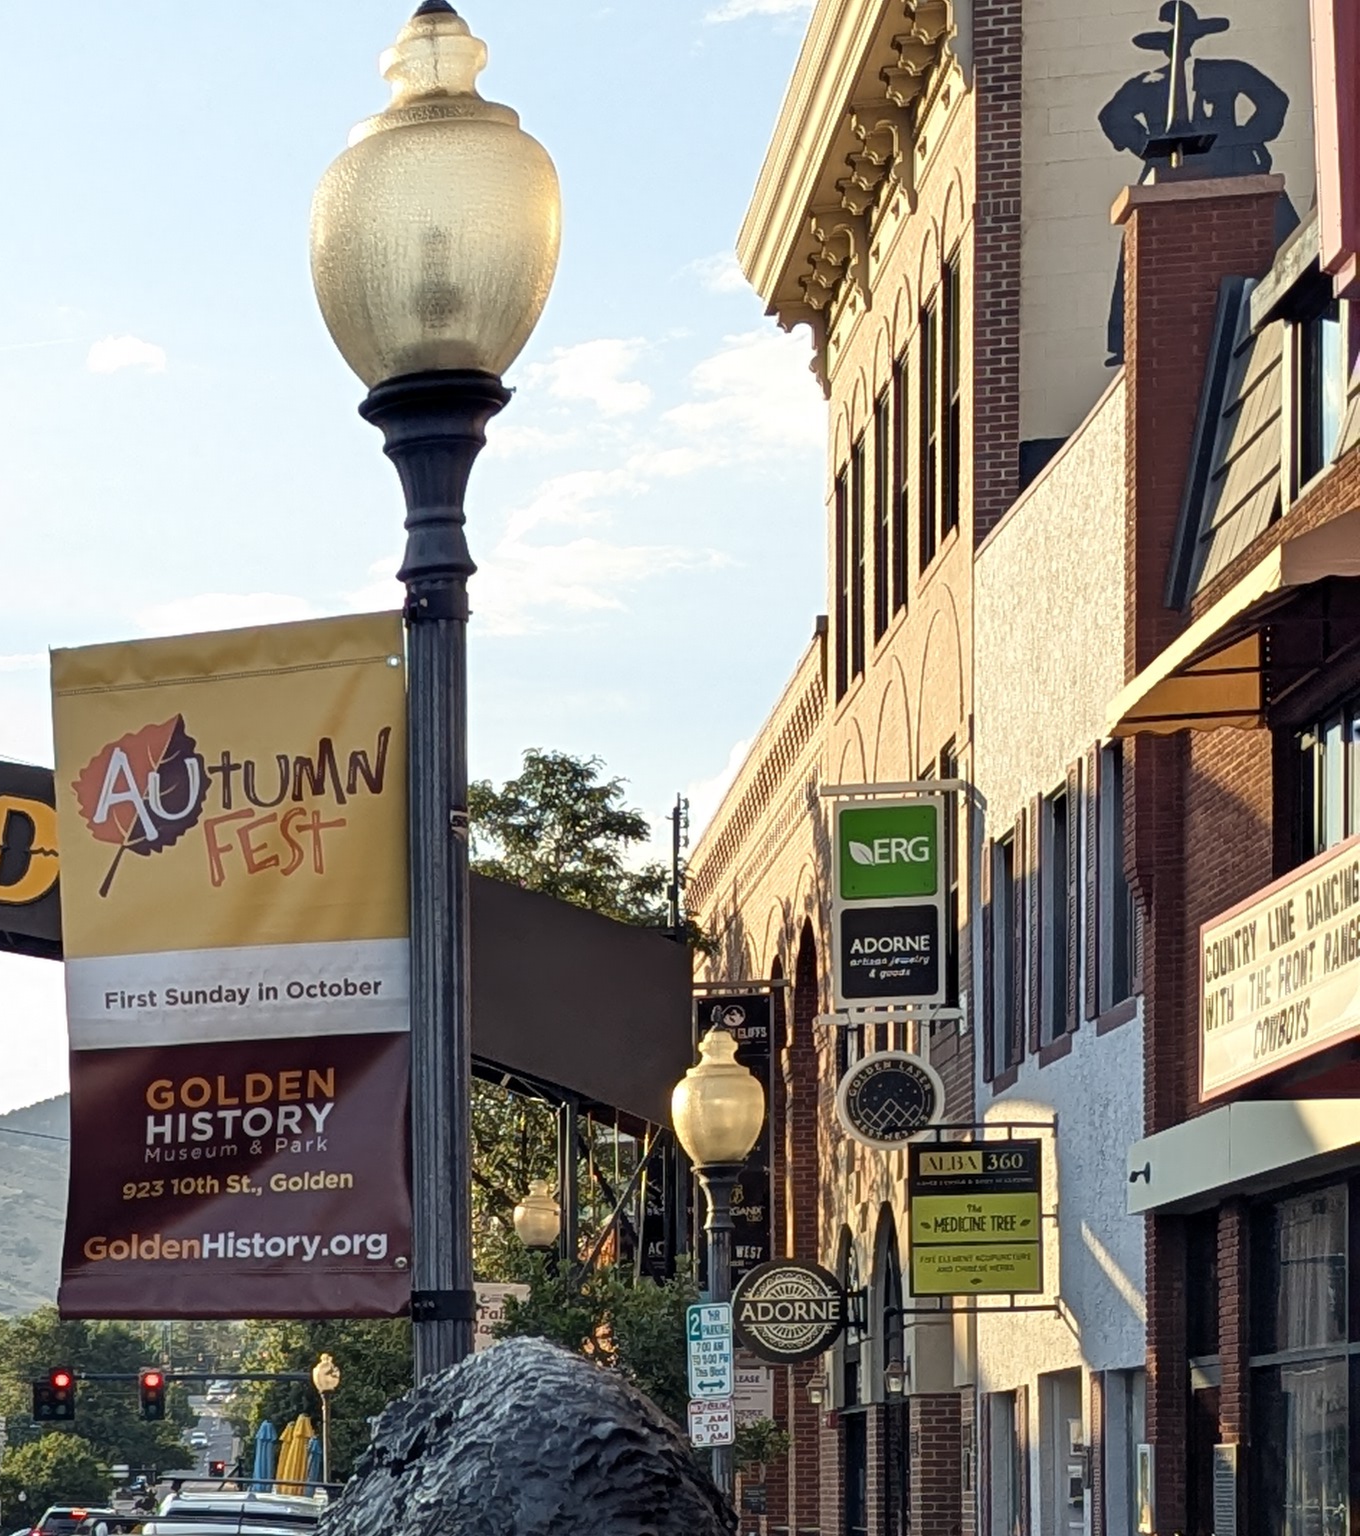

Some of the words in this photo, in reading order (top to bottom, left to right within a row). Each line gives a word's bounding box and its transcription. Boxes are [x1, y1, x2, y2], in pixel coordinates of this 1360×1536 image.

[203, 806, 347, 888] FEST
[873, 836, 930, 864] ERG
[1205, 919, 1257, 983] COUNTRY
[1267, 898, 1296, 952] LINE
[1305, 860, 1360, 931] DANCING
[850, 935, 930, 954] ADORNE
[849, 957, 887, 967] artisan
[888, 955, 930, 967] jewelry
[868, 969, 876, 978] &
[880, 968, 911, 979] goods
[105, 990, 158, 1009] First
[165, 984, 250, 1006] Sunday
[257, 982, 279, 1001] in
[286, 977, 382, 999] October
[1205, 983, 1235, 1032] WITH
[1248, 964, 1271, 1012] THE
[1278, 940, 1316, 998] FRONT
[1253, 996, 1311, 1059] COWBOYS
[146, 1067, 335, 1111] GOLDEN
[848, 1061, 892, 1097] GOLDEN
[899, 1061, 932, 1091] LASER
[145, 1102, 335, 1145] HISTORY
[144, 1142, 238, 1163] Museum
[249, 1139, 263, 1155] &
[275, 1136, 328, 1153] Park
[923, 1154, 978, 1172] ALBA
[987, 1152, 1024, 1171] 360
[122, 1178, 164, 1200] 923
[170, 1175, 219, 1195] 10th
[225, 1174, 263, 1196] St.,
[269, 1171, 354, 1192] Golden
[966, 1203, 983, 1213] The
[933, 1215, 986, 1233] MEDICINE
[990, 1214, 1017, 1231] TREE
[83, 1231, 388, 1261] GoldenHistory.org
[735, 1245, 763, 1259] WEST
[740, 1301, 841, 1321] ADORNE
[690, 1313, 700, 1336] 2
[694, 1416, 703, 1425] 2
[709, 1414, 729, 1423] AM
[703, 1423, 720, 1433] TO
[710, 1431, 729, 1442] AM
